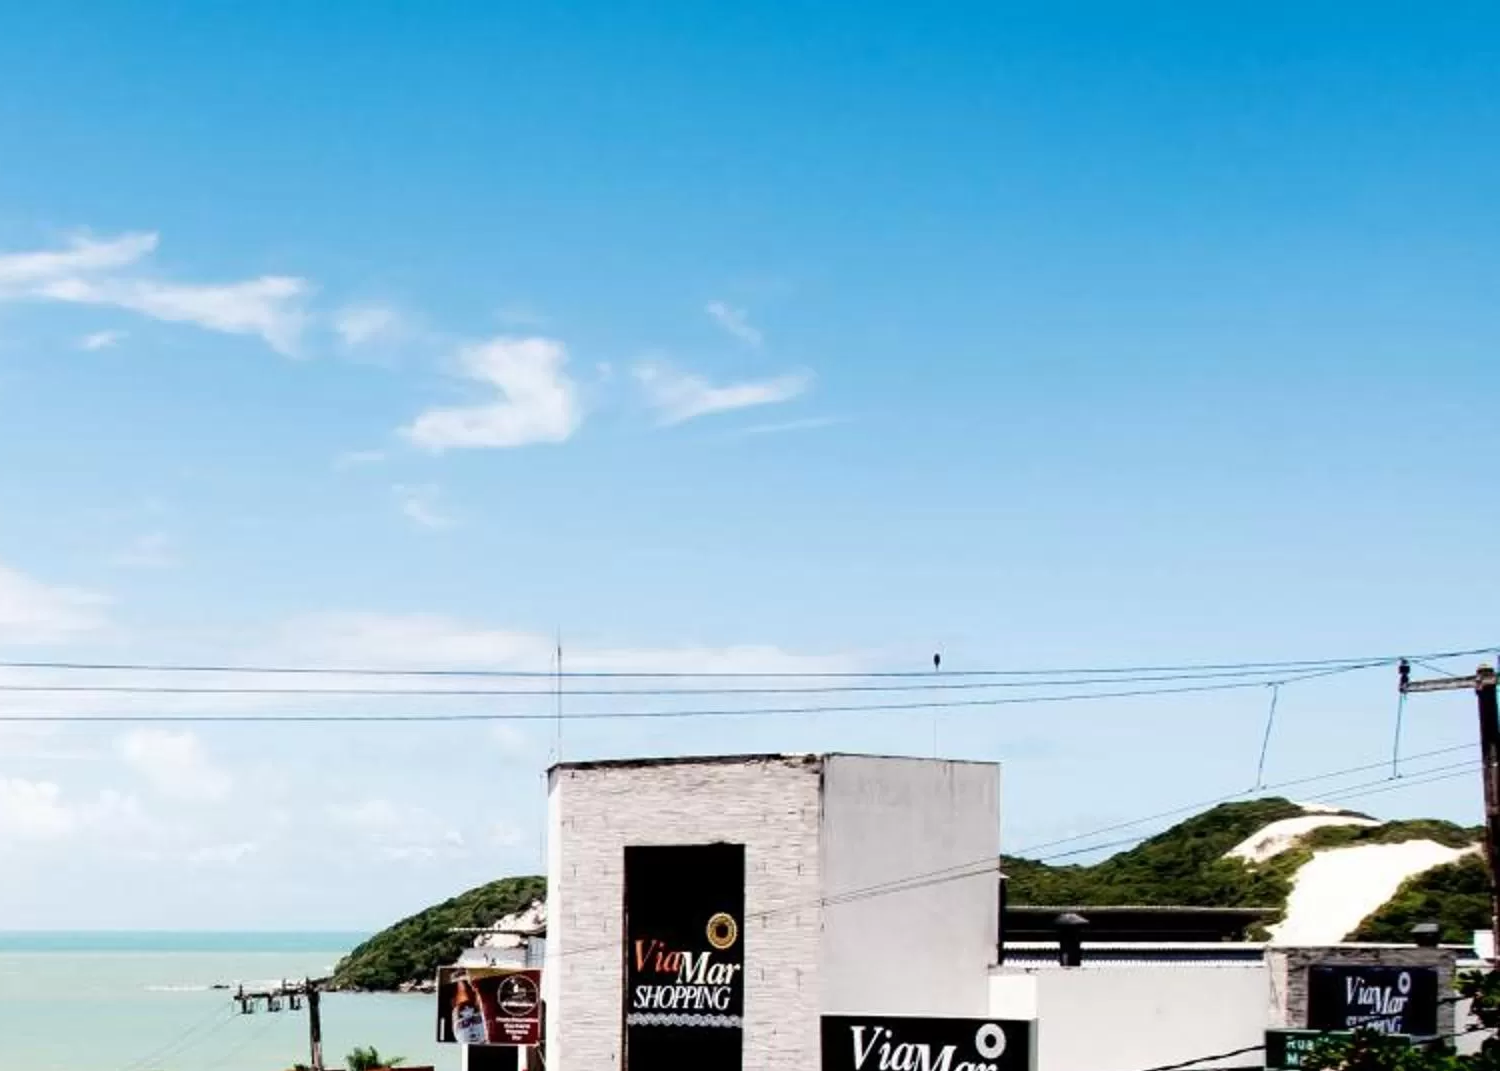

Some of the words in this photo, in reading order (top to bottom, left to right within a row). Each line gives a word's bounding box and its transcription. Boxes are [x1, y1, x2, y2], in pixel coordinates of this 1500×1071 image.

[635, 940, 740, 985] ViaMar
[633, 985, 732, 1010] SHOPPING
[1345, 976, 1408, 1015] ViaMar
